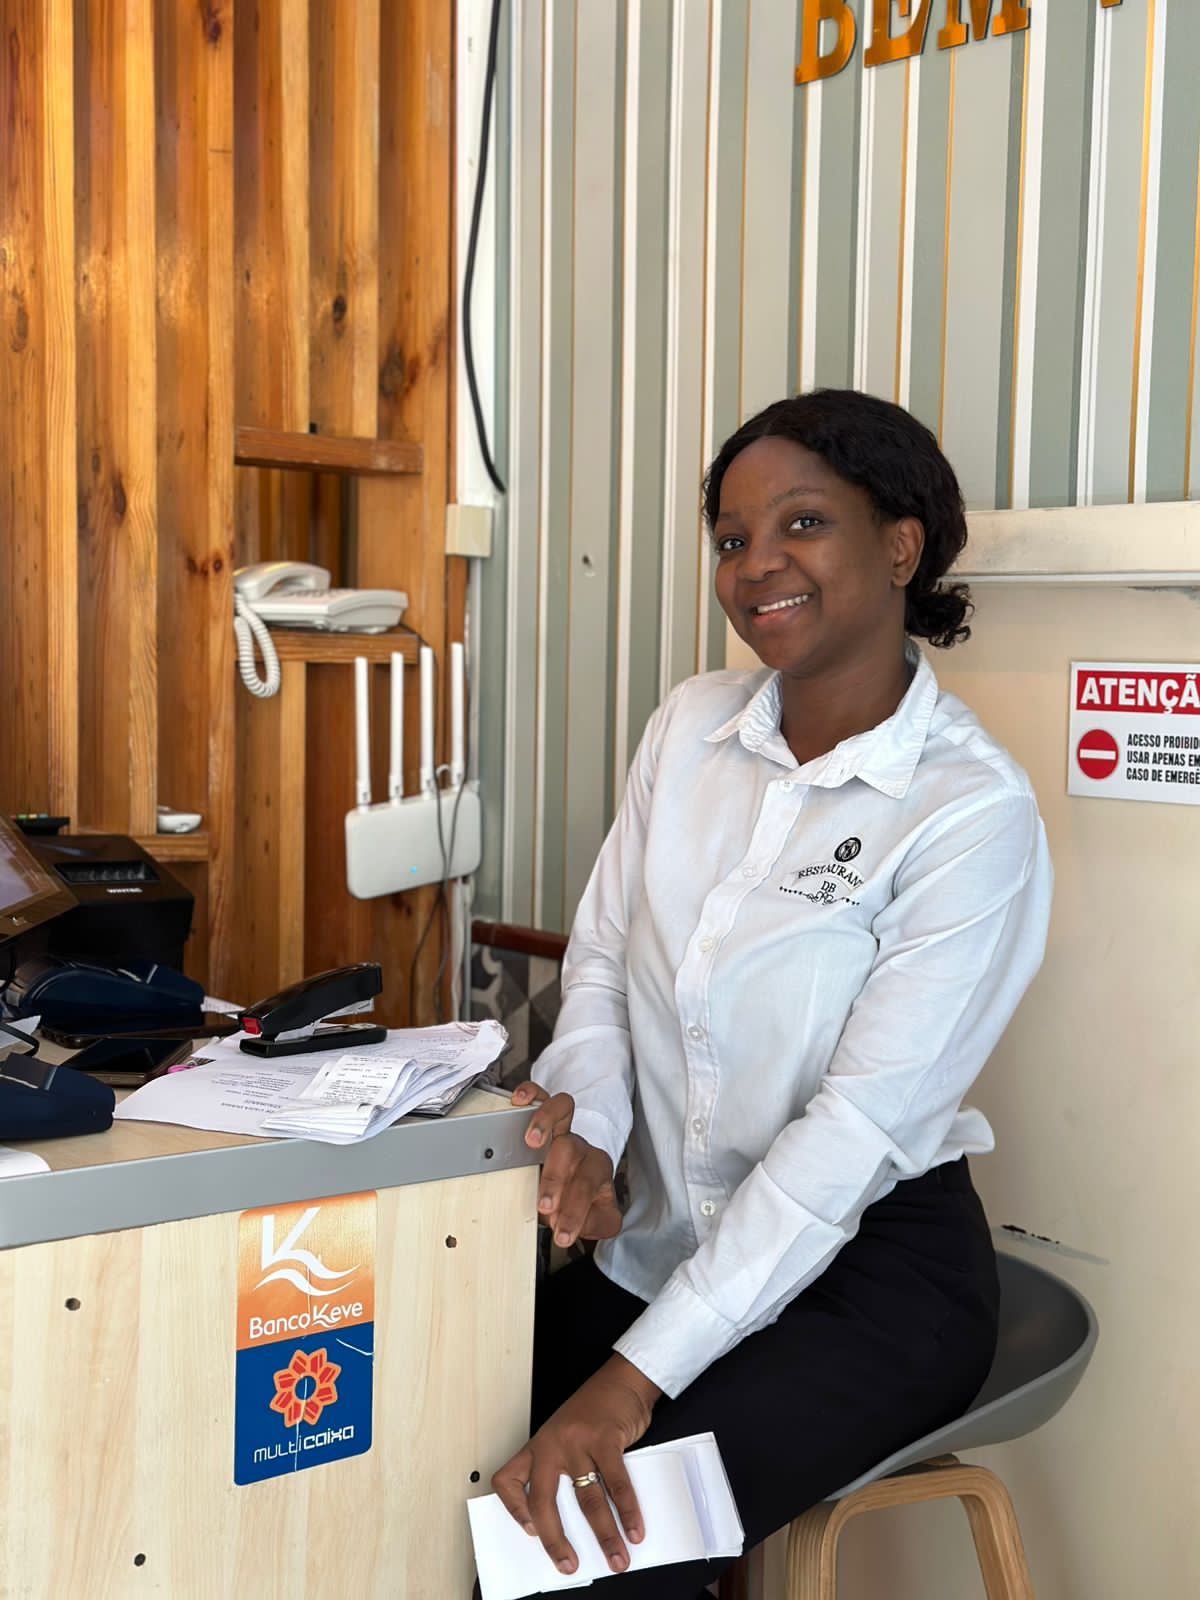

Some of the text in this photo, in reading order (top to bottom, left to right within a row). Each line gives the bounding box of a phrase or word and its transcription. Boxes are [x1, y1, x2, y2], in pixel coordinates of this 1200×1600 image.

[1127, 733, 1200, 750] ACESSO PROIBID
[1127, 750, 1150, 764] USAR
[1152, 752, 1186, 767] APENAS
[1126, 767, 1149, 781] CASO
[1151, 769, 1163, 782] DE
